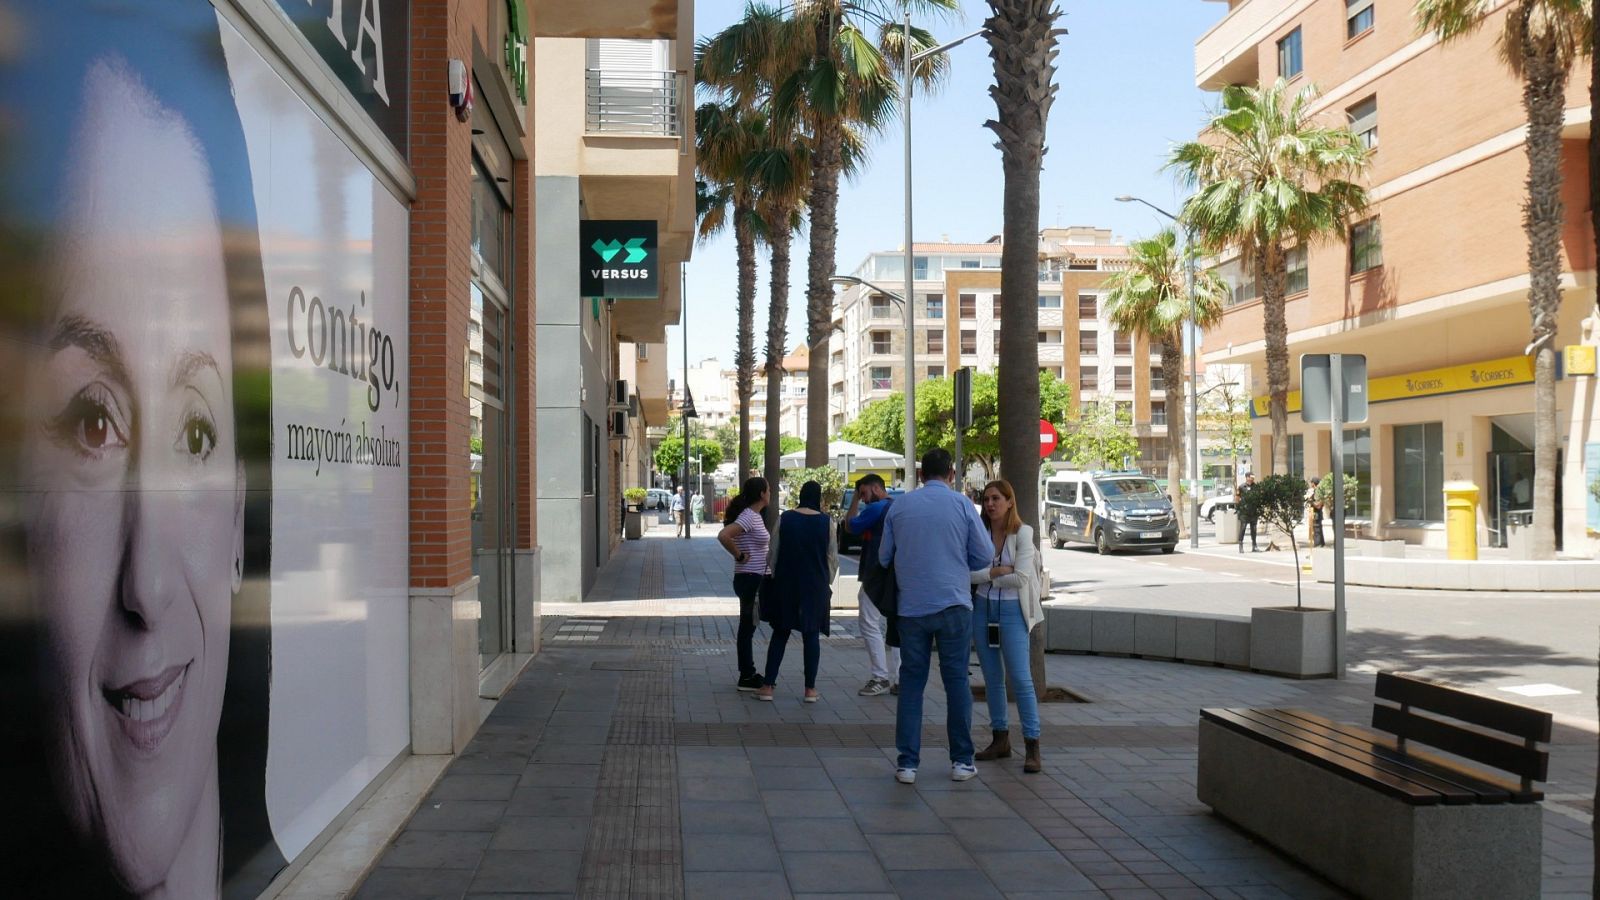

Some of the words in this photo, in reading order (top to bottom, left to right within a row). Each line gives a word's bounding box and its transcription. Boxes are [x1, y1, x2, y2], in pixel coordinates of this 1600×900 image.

[591, 269, 649, 279] VERSUS
[287, 286, 399, 412] contigo,
[287, 418, 352, 476] mayoría
[356, 421, 400, 467] absoluta
